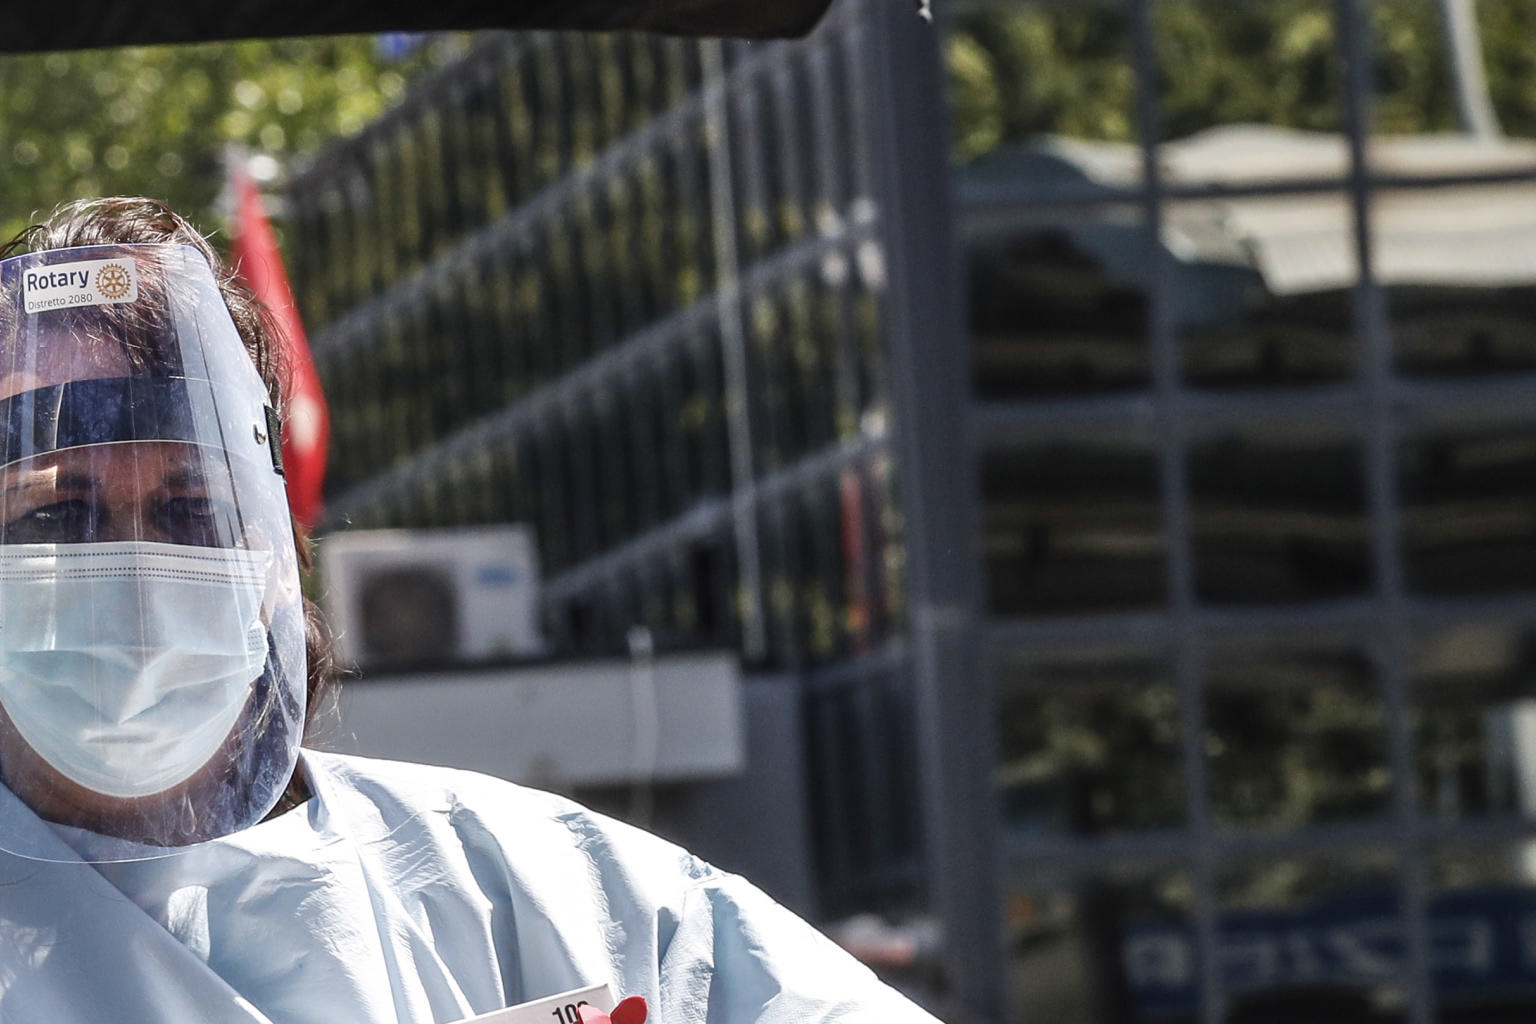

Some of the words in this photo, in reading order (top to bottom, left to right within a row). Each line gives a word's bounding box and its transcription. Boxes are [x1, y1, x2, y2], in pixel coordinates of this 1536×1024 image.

[27, 270, 89, 292] Rotary
[28, 297, 66, 310] Distretto
[69, 293, 93, 304] 2080
